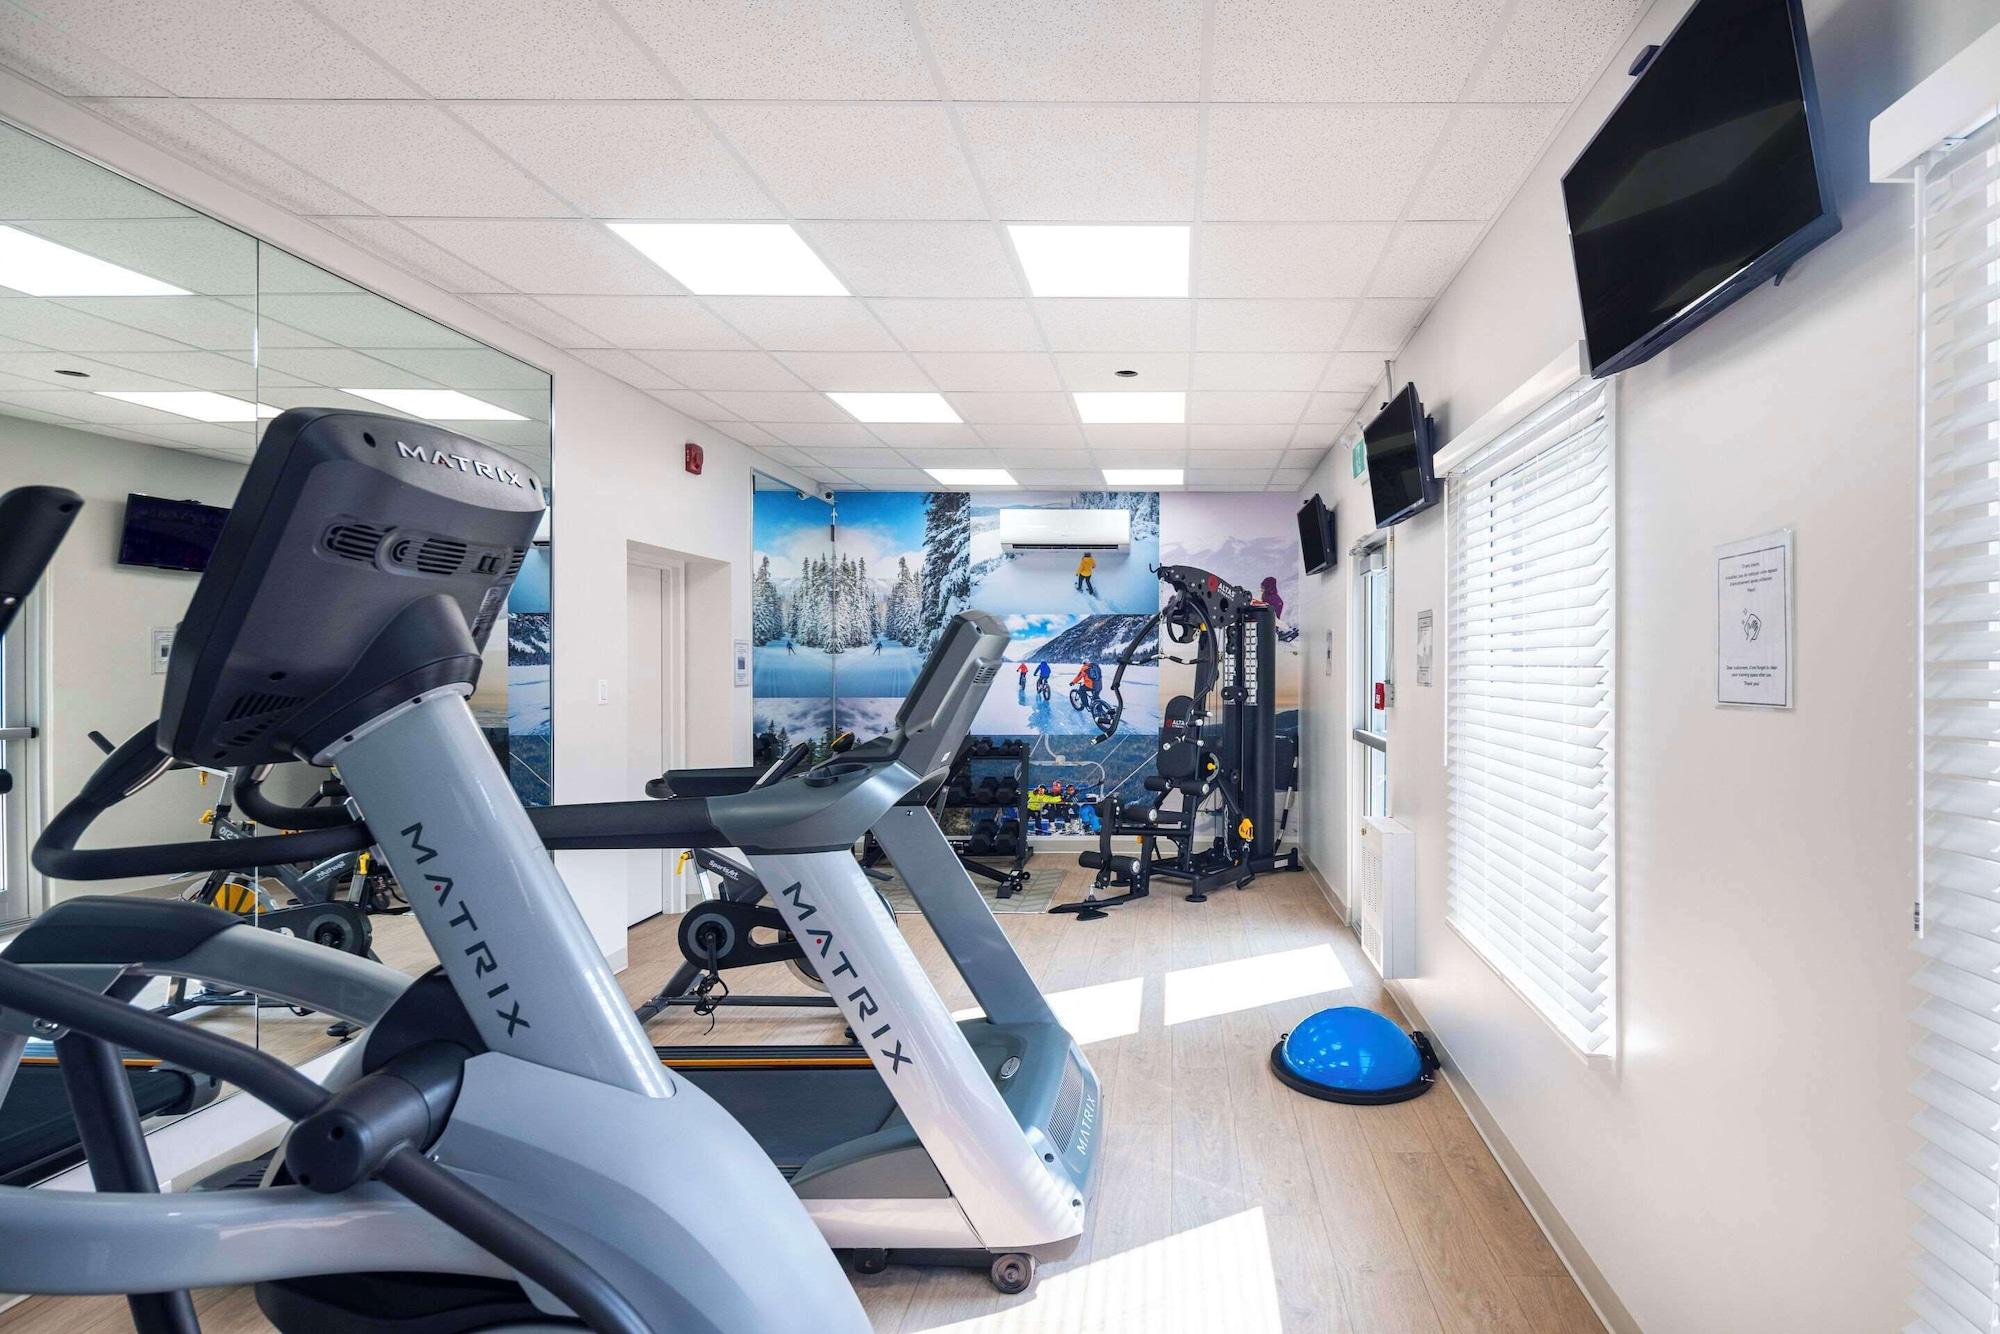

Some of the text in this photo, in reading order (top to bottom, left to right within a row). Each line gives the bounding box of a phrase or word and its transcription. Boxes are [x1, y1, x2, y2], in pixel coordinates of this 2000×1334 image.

[397, 440, 523, 488] MATRIX
[401, 822, 531, 1038] MATRIX
[782, 881, 913, 1075] MATRIX
[1076, 1095, 1097, 1155] MATRIX
